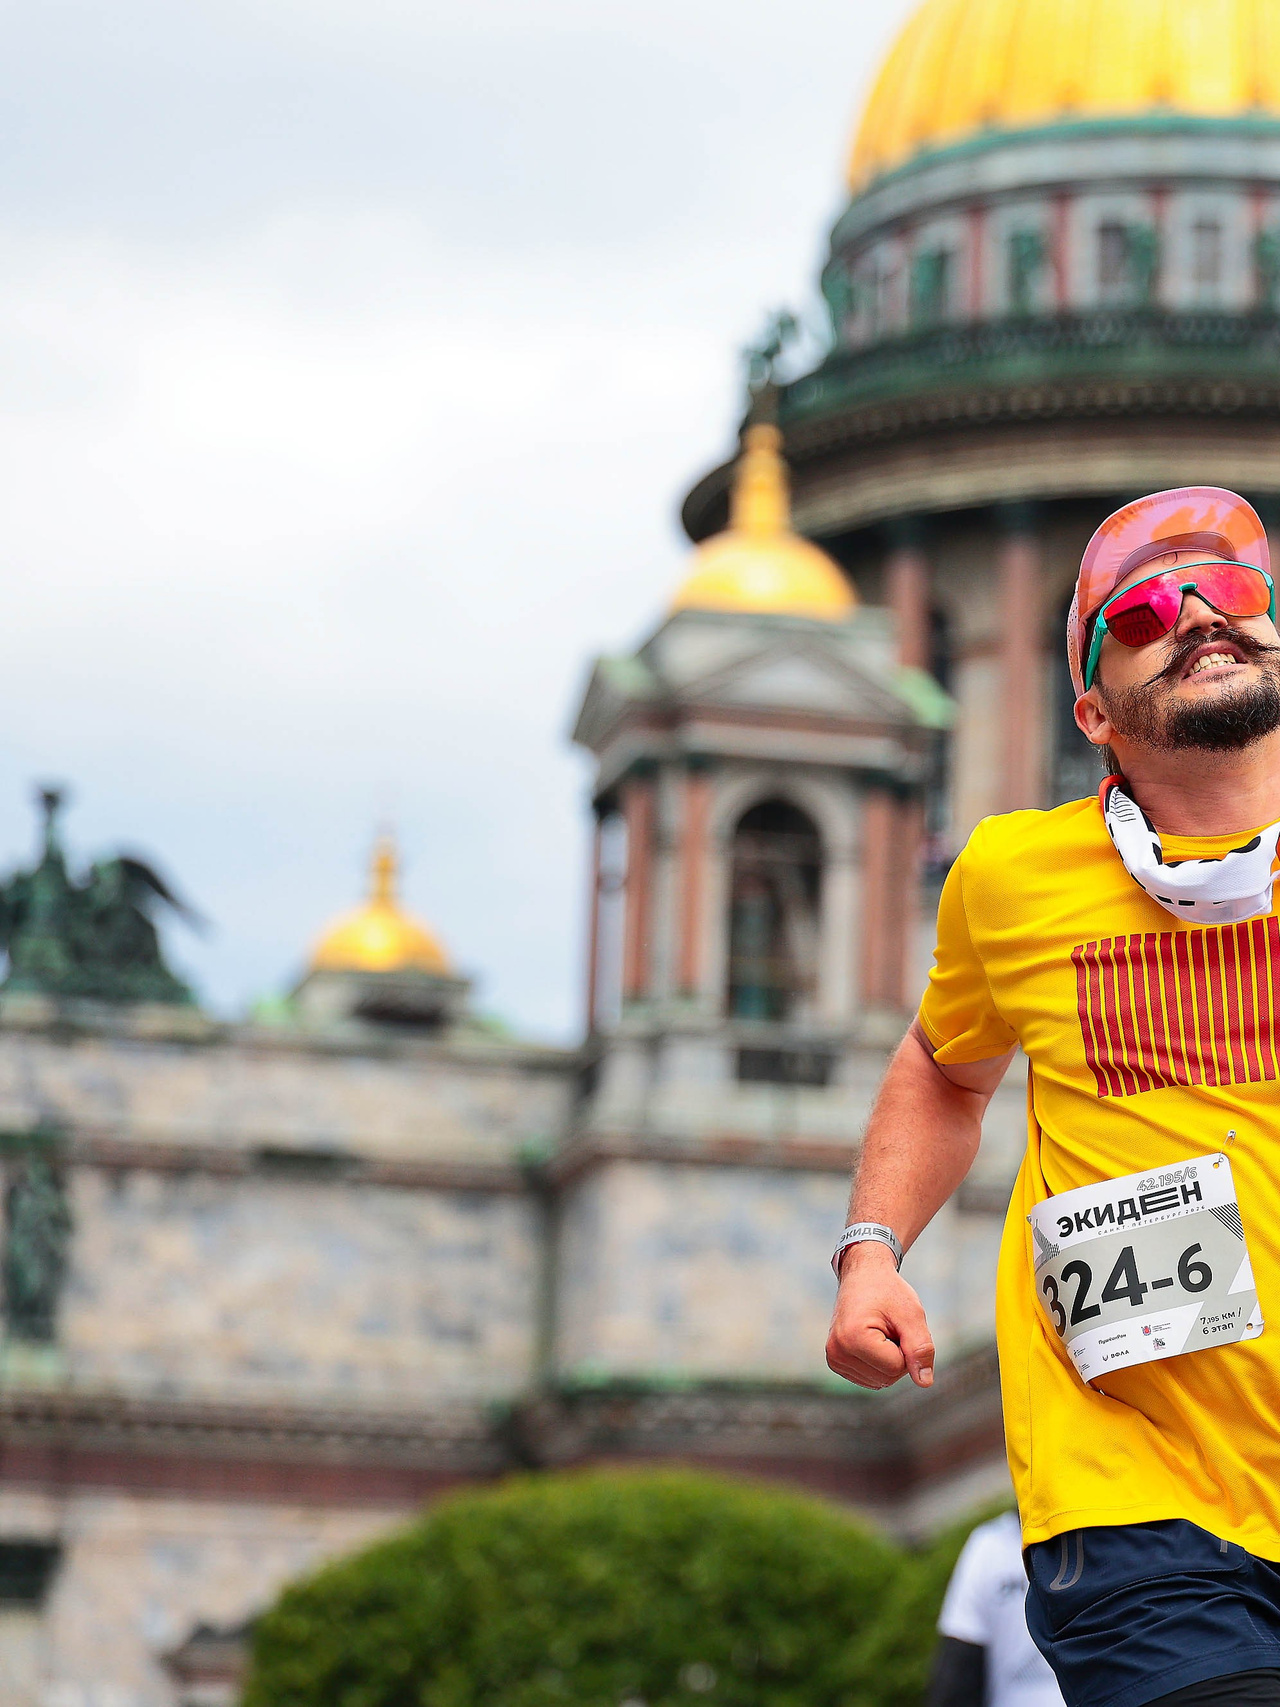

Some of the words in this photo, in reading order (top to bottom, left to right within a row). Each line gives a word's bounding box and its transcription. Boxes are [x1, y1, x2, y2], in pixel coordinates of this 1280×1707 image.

[1137, 1166, 1198, 1192] 42.195/6
[1056, 1180, 1203, 1238] ЭКИДЕН
[840, 1227, 896, 1246] ЭКИДЕН
[1042, 1242, 1213, 1338] 324-6
[1202, 1326, 1210, 1335] 6
[1211, 1322, 1235, 1333] этап
